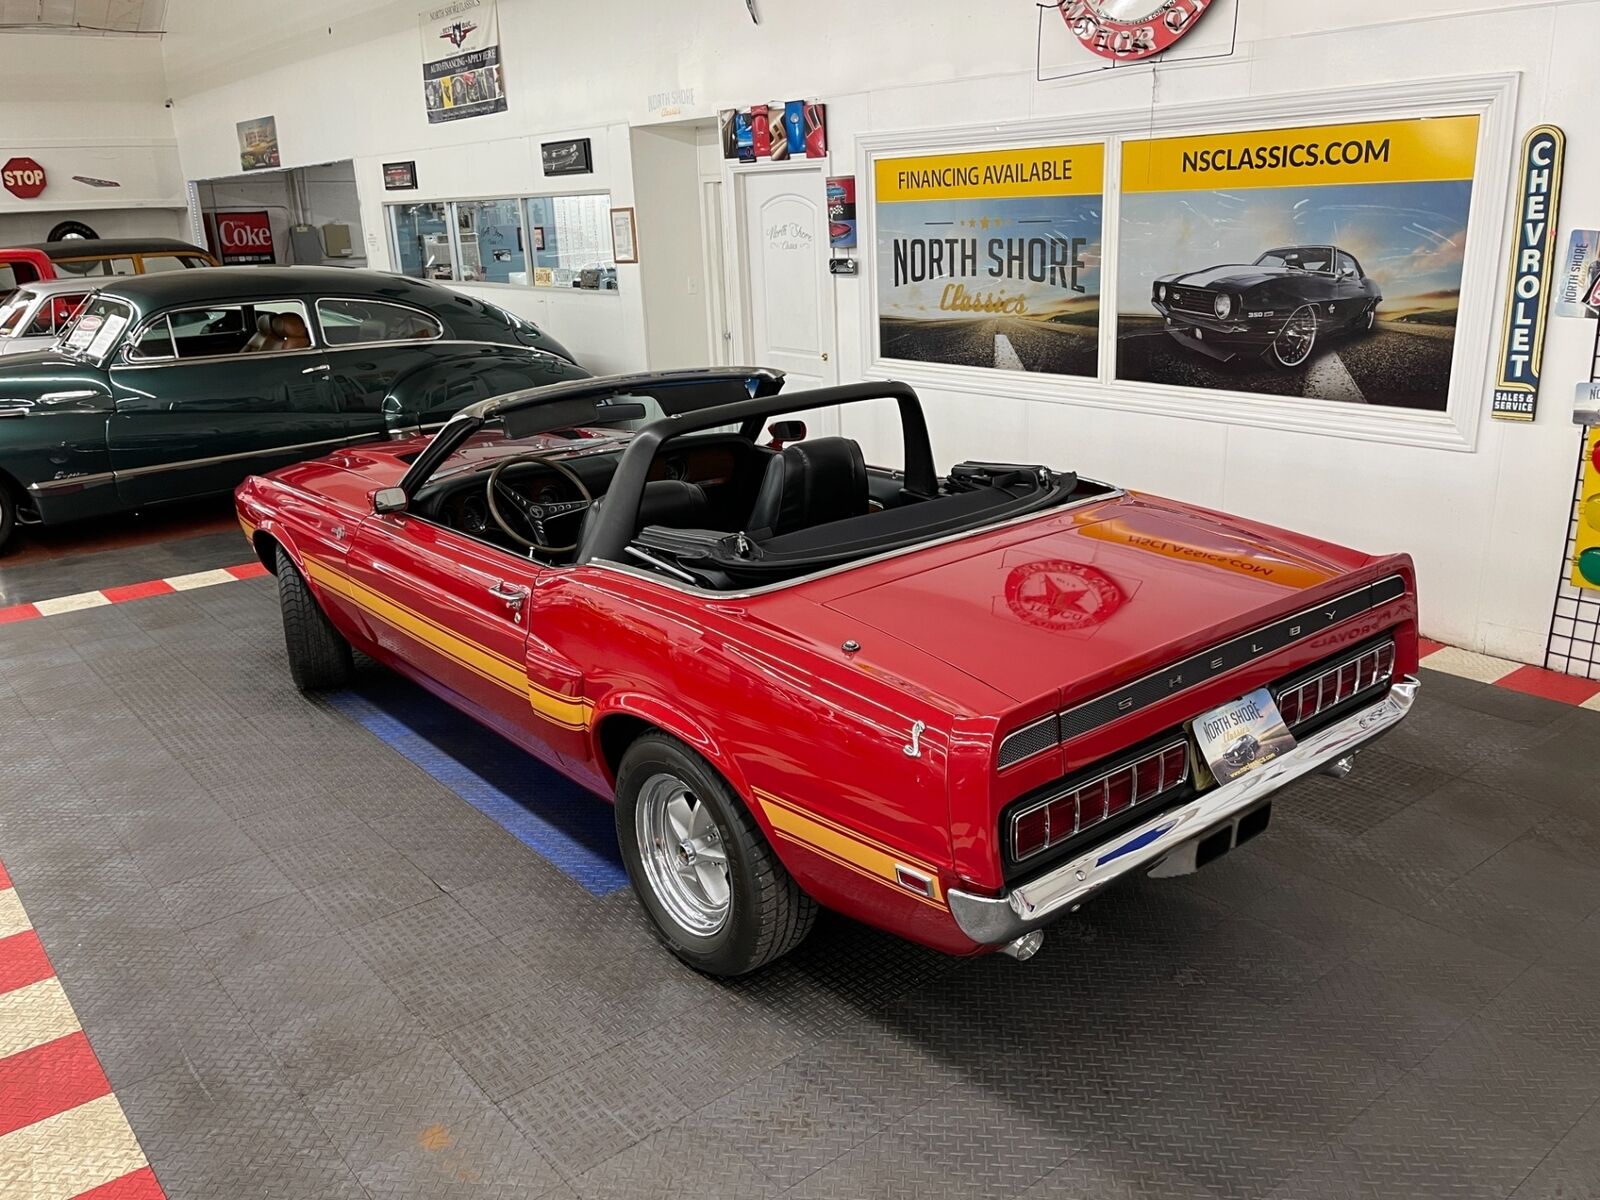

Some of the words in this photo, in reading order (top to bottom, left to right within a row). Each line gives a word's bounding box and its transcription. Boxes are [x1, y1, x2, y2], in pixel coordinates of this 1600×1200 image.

[1182, 138, 1390, 172] NSCLASSICS.COM
[4, 169, 43, 186] STOP
[898, 166, 979, 190] FINANCING
[983, 159, 1073, 185] AVAILABLE
[219, 220, 271, 247] Coke
[893, 238, 977, 287] NORTH
[987, 237, 1087, 294] SHORE
[1509, 140, 1553, 378] CHEVROLET
[1563, 274, 1579, 304] NORTH
[1571, 243, 1589, 273] SHORE
[939, 283, 1029, 314] Classics
[1494, 401, 1533, 412] SERVICE
[1496, 392, 1524, 402] SALES
[1526, 394, 1534, 403] &
[1117, 609, 1337, 710] SHELBY
[1203, 717, 1232, 744] NORTH
[1229, 701, 1264, 726] SHORE
